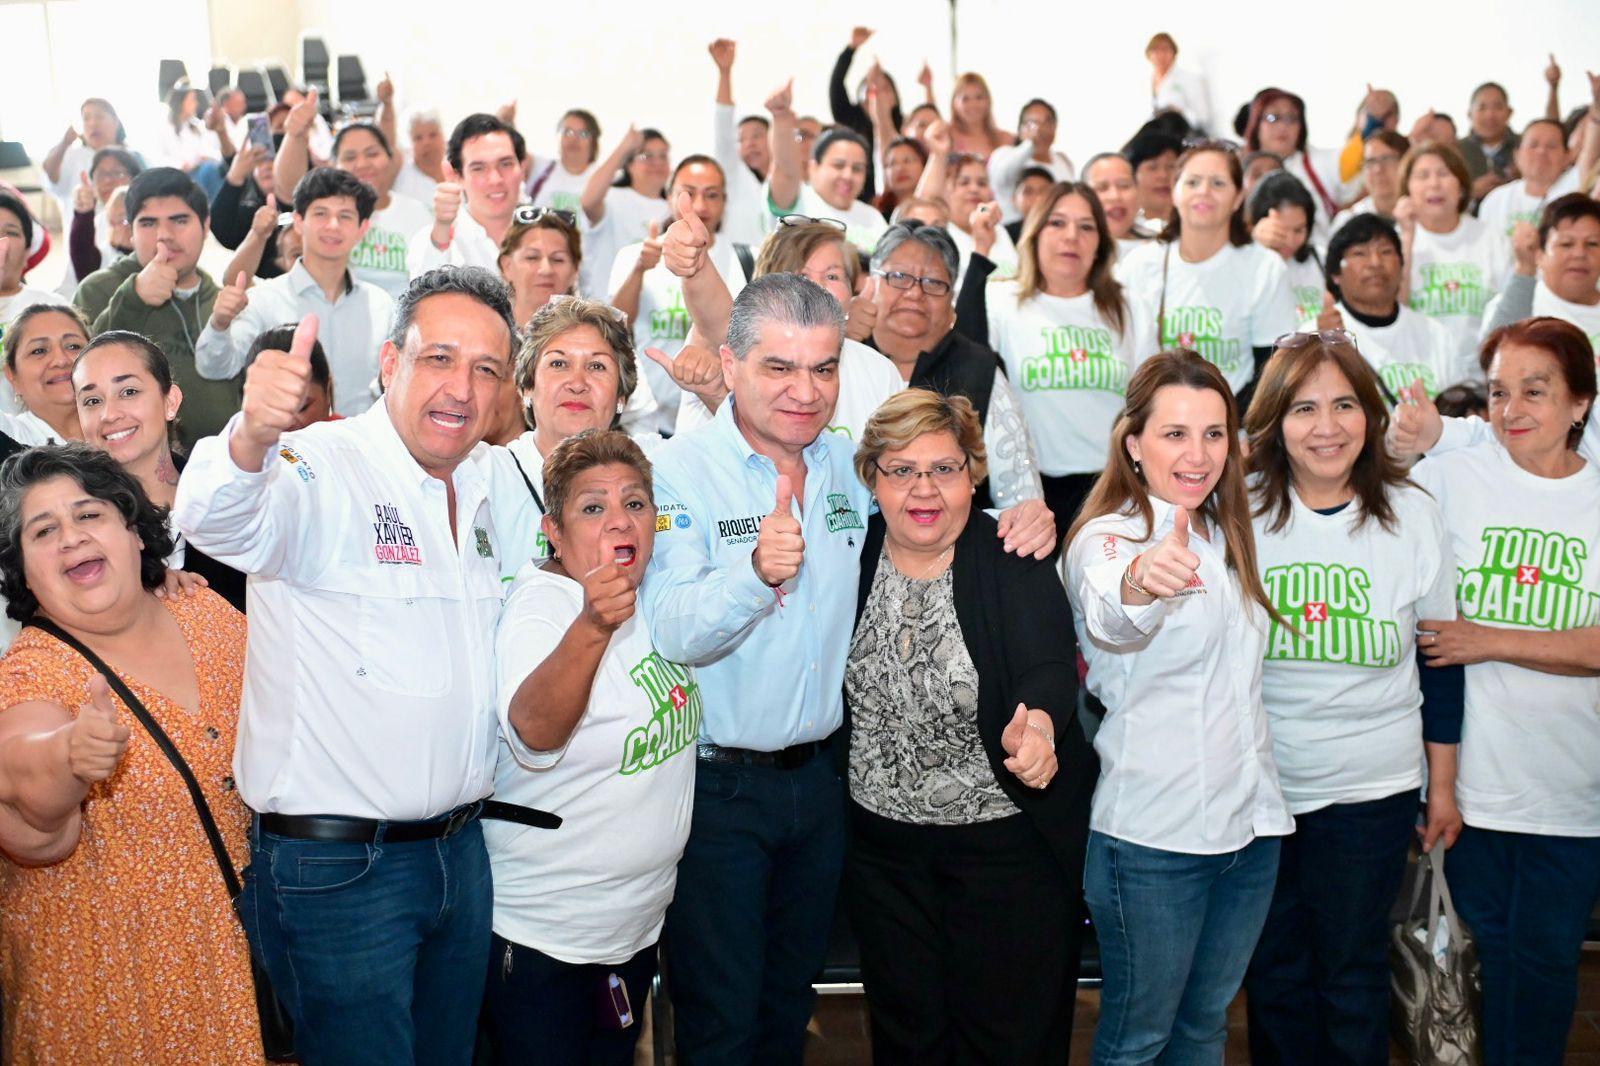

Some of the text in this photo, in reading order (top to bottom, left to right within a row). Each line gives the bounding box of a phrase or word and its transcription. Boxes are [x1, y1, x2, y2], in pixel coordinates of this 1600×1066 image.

[1041, 325, 1113, 356] TODOS
[374, 502, 404, 526] RAÚL
[718, 514, 767, 538] RIQUEL
[373, 522, 416, 547] XAVIER
[1482, 527, 1587, 585] TODOS
[1518, 566, 1539, 584] X
[1264, 562, 1371, 617] TODOS
[1306, 603, 1327, 621] X
[1264, 613, 1402, 668] AHUILA
[671, 687, 688, 709] X
